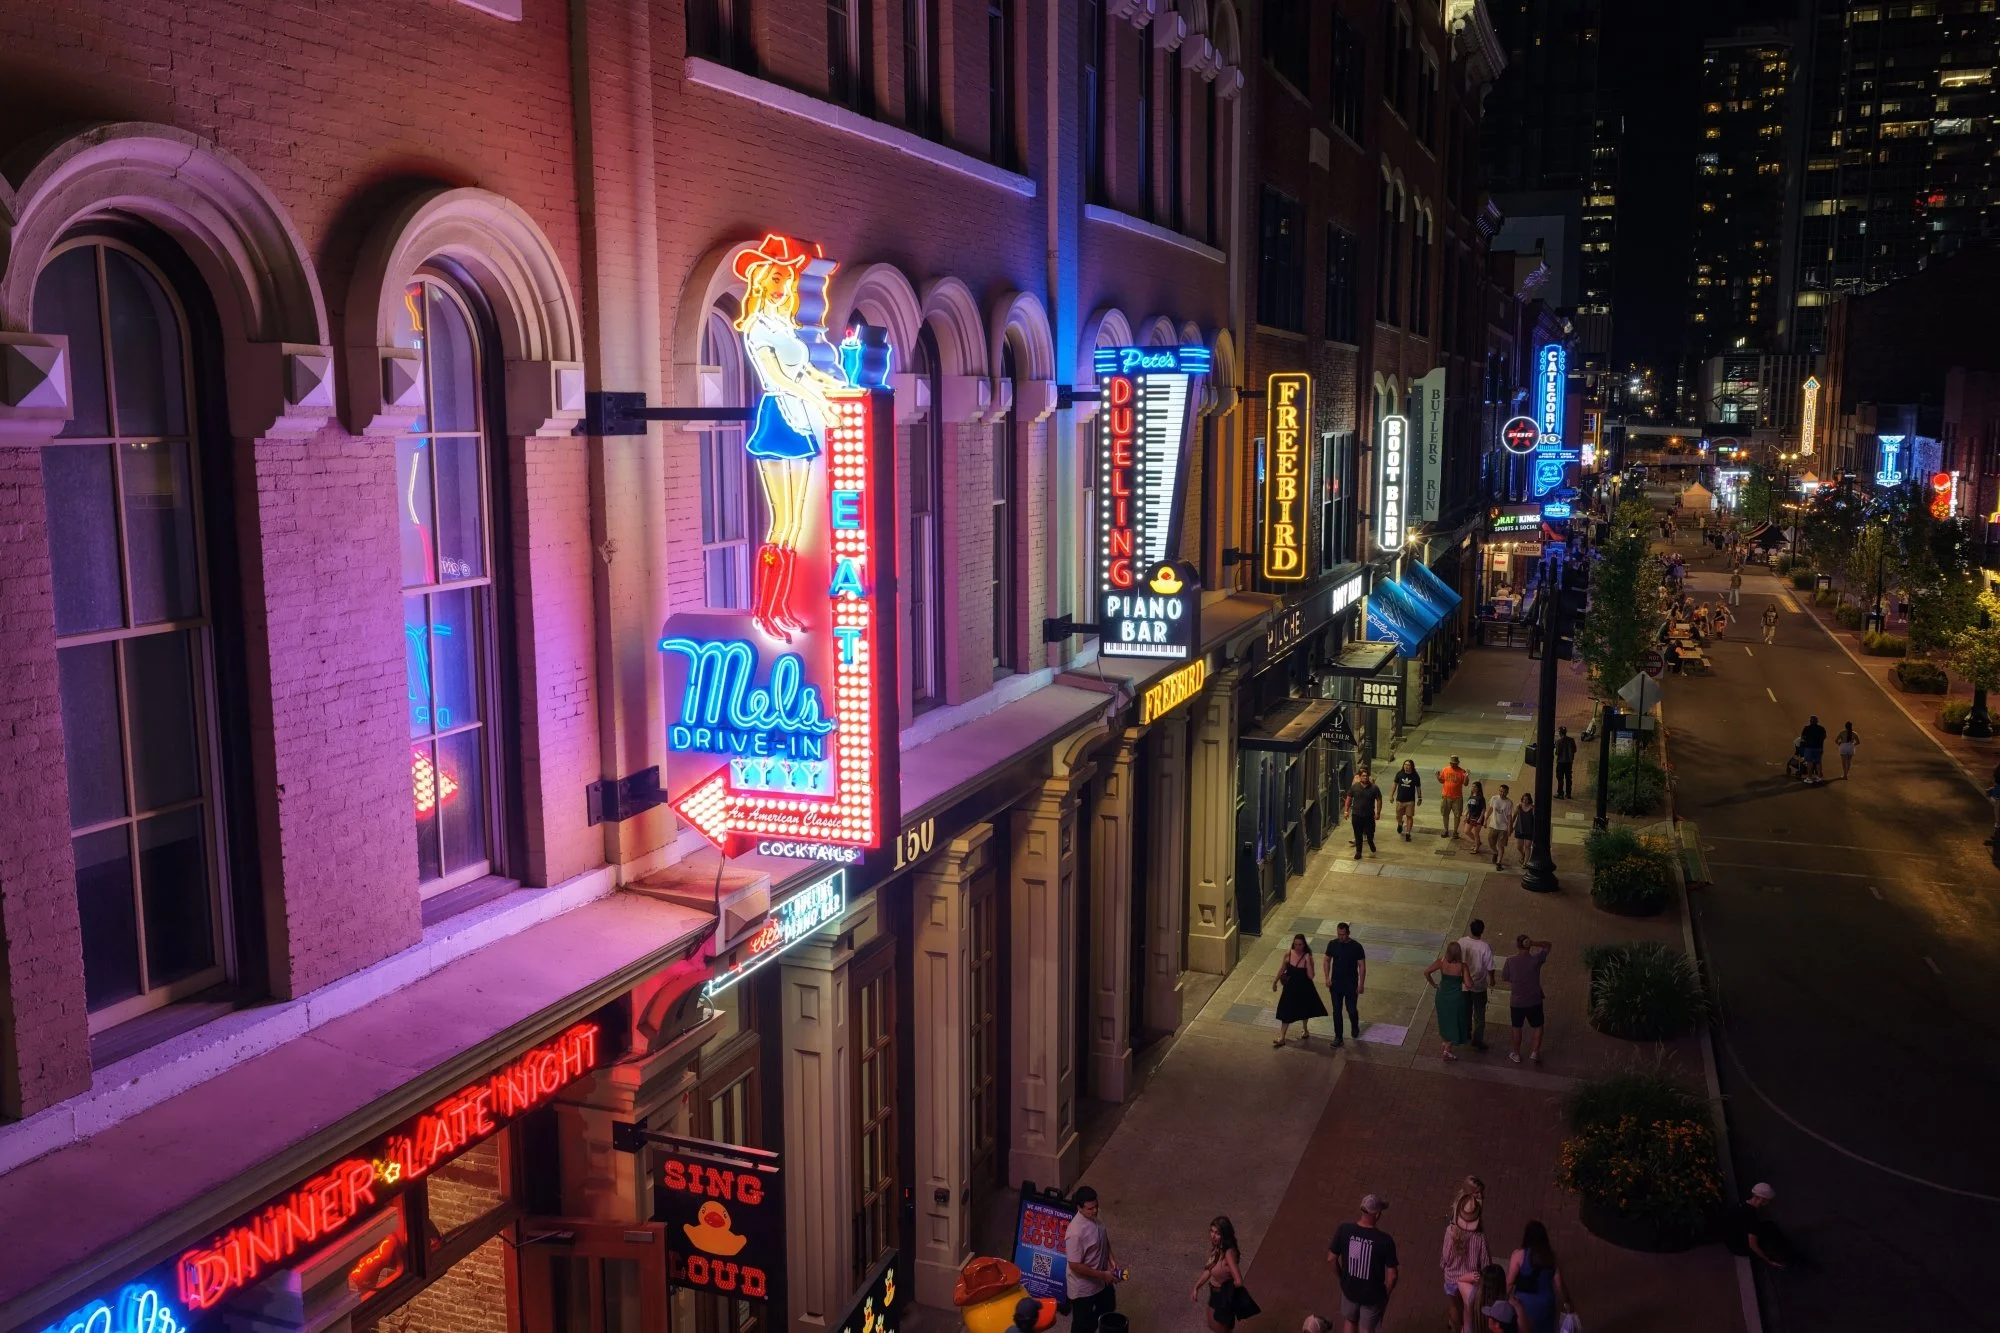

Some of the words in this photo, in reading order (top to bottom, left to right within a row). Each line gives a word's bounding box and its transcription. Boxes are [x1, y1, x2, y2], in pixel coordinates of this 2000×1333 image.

[1119, 349, 1176, 373] Pete's
[1545, 351, 1558, 433] CATEGORY
[1428, 388, 1441, 465] BUTLERS
[1540, 434, 1561, 445] 10
[1386, 420, 1401, 482] BOOT
[1109, 376, 1133, 588] DUELING
[1272, 381, 1300, 571] FREEBIRD
[1425, 479, 1436, 511] RUN
[1385, 486, 1399, 547] BARN
[828, 490, 870, 665] EAT
[1107, 595, 1182, 619] PIANO
[1121, 620, 1168, 643] BAR
[659, 638, 834, 734] Mels
[1145, 659, 1205, 725] FREEBIRD
[1363, 683, 1398, 695] BOOT
[1363, 694, 1397, 706] BARN
[671, 725, 823, 759] DRIVE-IN
[726, 806, 745, 819] An
[746, 807, 800, 825] American
[802, 811, 843, 828] Classic
[759, 841, 855, 863] COCKTAILS
[893, 816, 935, 872] 150
[784, 908, 818, 944] PIANO
[821, 893, 841, 921] BAR
[186, 1161, 376, 1309] DINNER
[398, 1087, 496, 1178] LATE
[495, 1025, 599, 1117] NIGHT
[664, 1159, 765, 1205] SING
[1043, 1207, 1054, 1215] OPEN
[1350, 1235, 1374, 1244] ARIAT
[669, 1250, 768, 1297] LOUD
